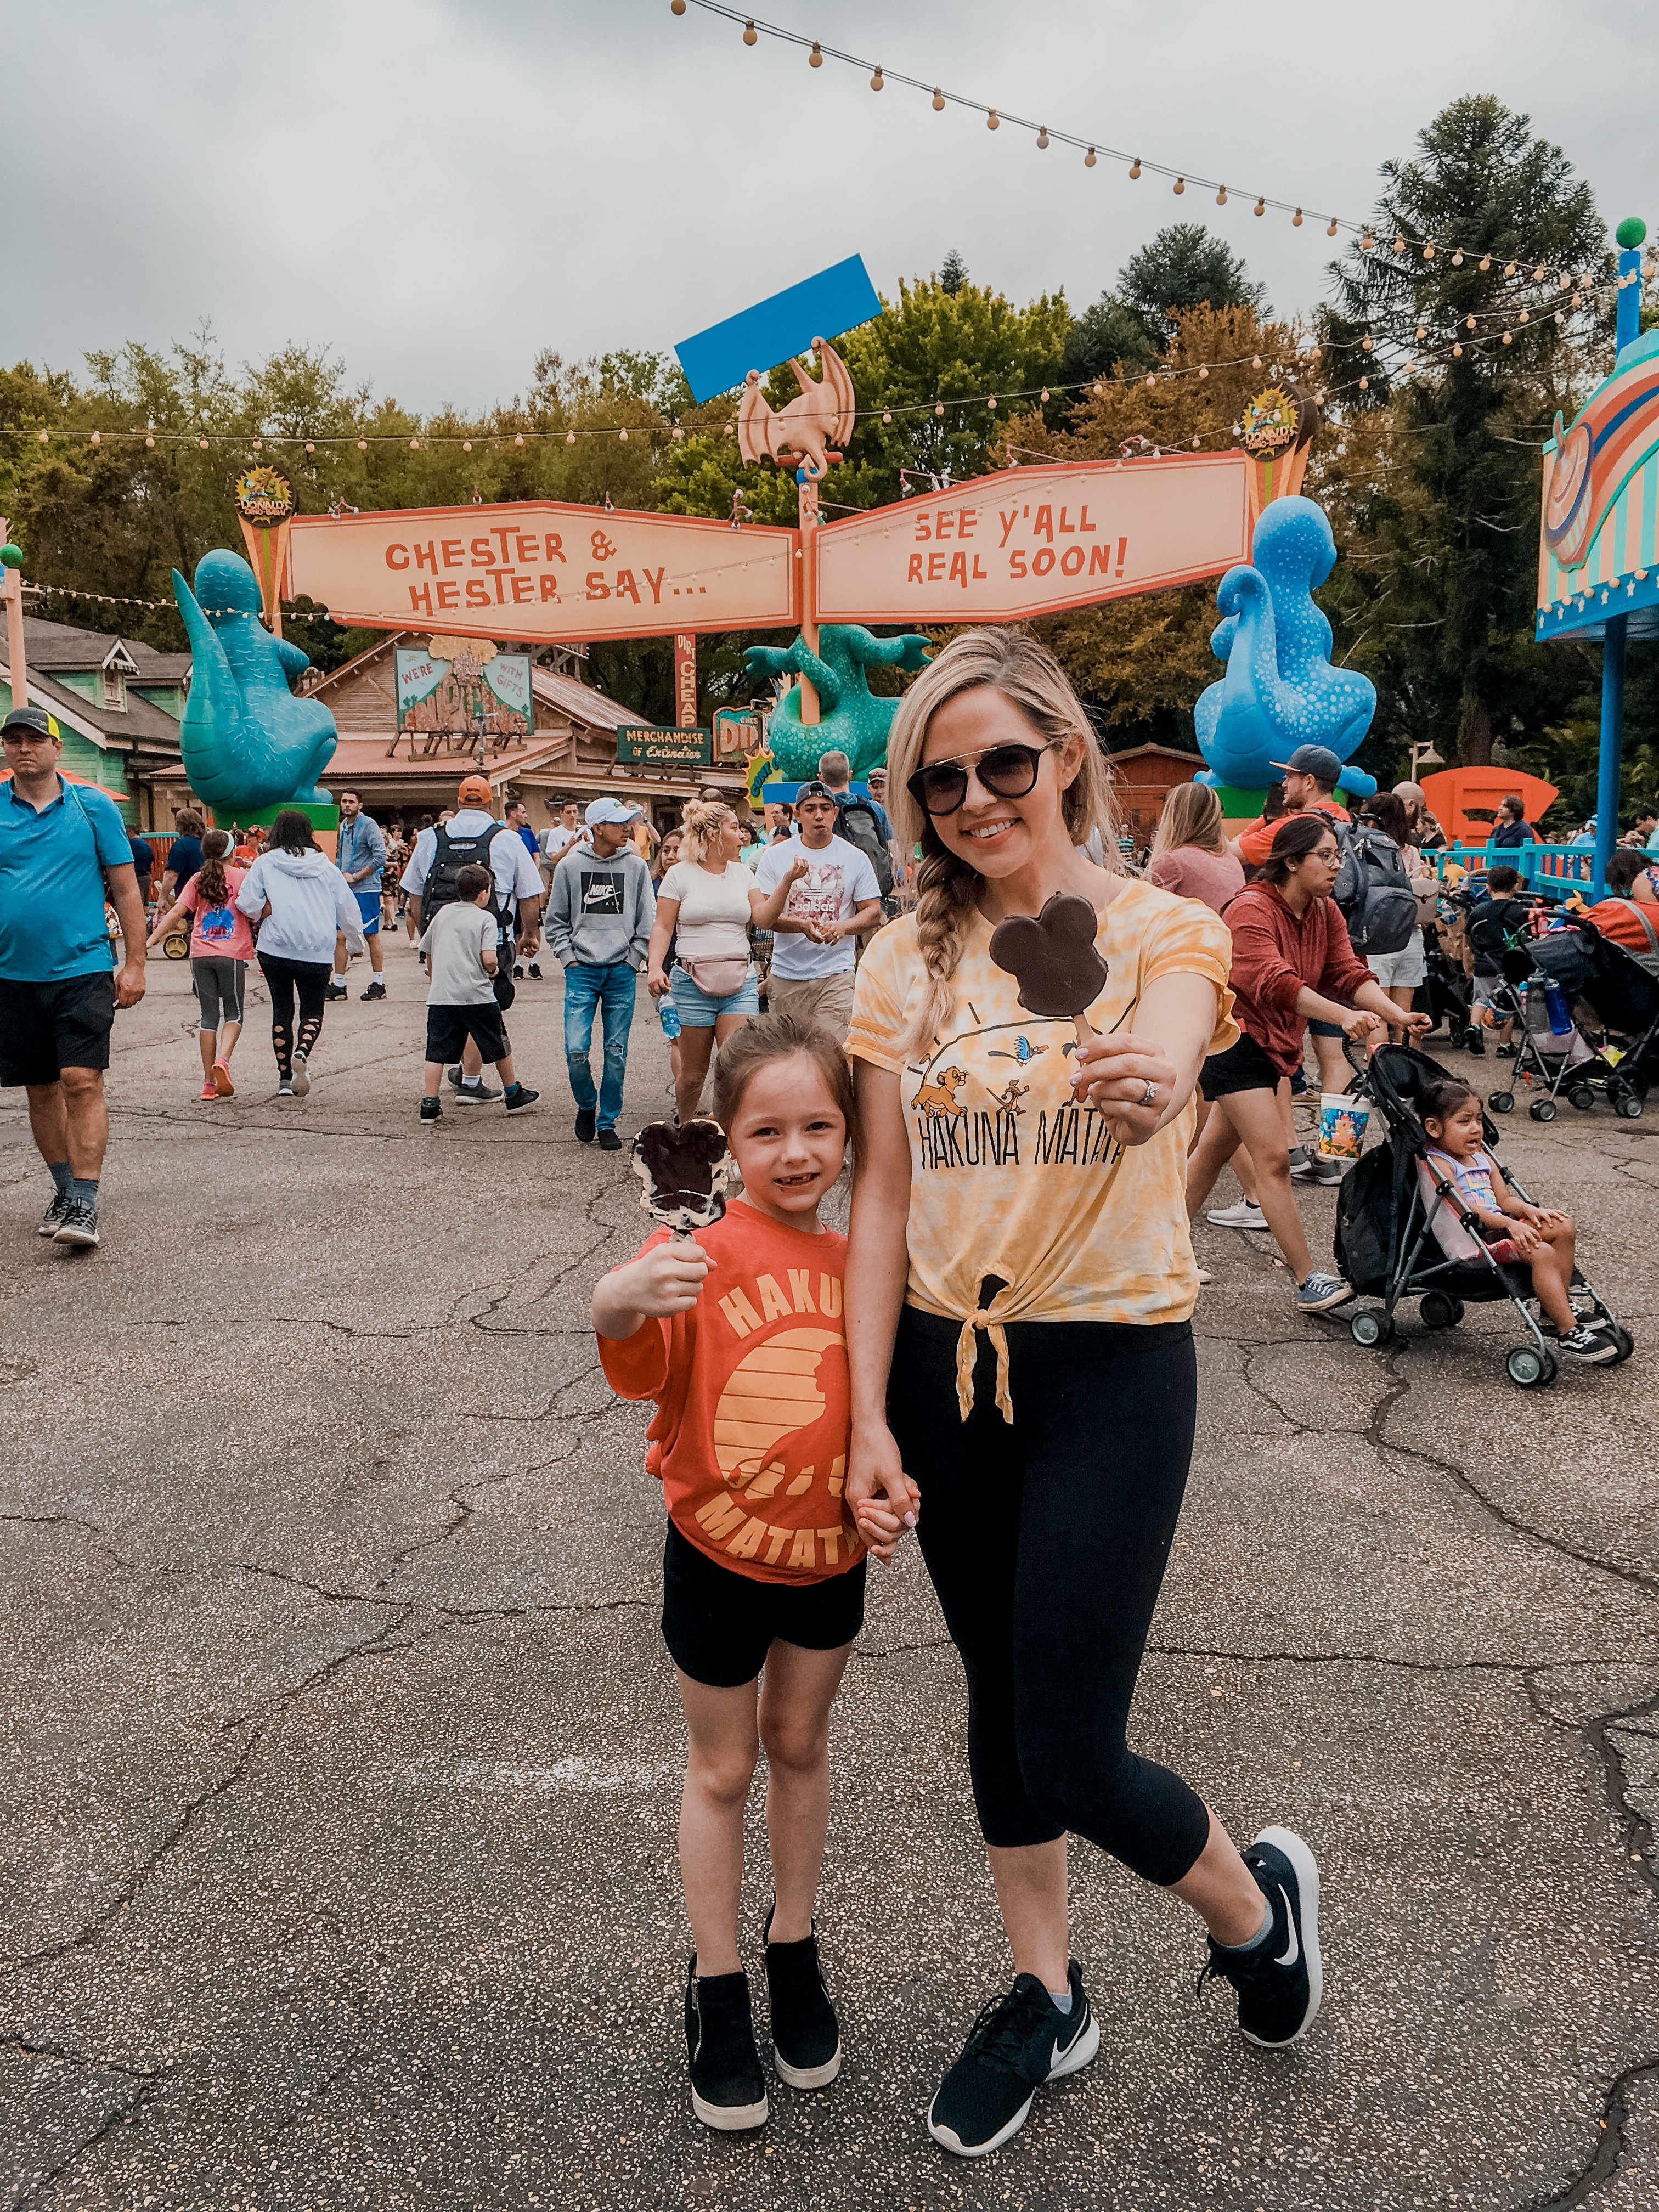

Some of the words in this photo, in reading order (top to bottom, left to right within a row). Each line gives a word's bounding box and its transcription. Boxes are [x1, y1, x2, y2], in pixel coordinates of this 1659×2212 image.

[1245, 424, 1294, 444] DONALD'S
[240, 499, 289, 511] DONALD'S
[916, 510, 978, 541] SEE
[999, 505, 1096, 548] Y'ALL
[386, 526, 567, 575] CHESTER
[591, 530, 617, 562] &
[908, 552, 988, 588] REAL
[1009, 537, 1128, 579] SOON!
[409, 568, 562, 617] HESTER
[586, 567, 707, 605] SAY...
[678, 635, 696, 659] DIRT
[402, 663, 433, 684] WE'RE
[500, 663, 523, 680] WITH
[496, 674, 524, 697] GIFTS
[680, 661, 696, 728] CHEAP
[626, 730, 704, 744] MERCHANDISE
[633, 747, 643, 757] OF
[751, 761, 772, 797] GONE
[589, 884, 614, 896] NIKE
[795, 900, 836, 912] adidas
[918, 1110, 1020, 1170] HAKUNA
[718, 1268, 842, 1339] HAKU
